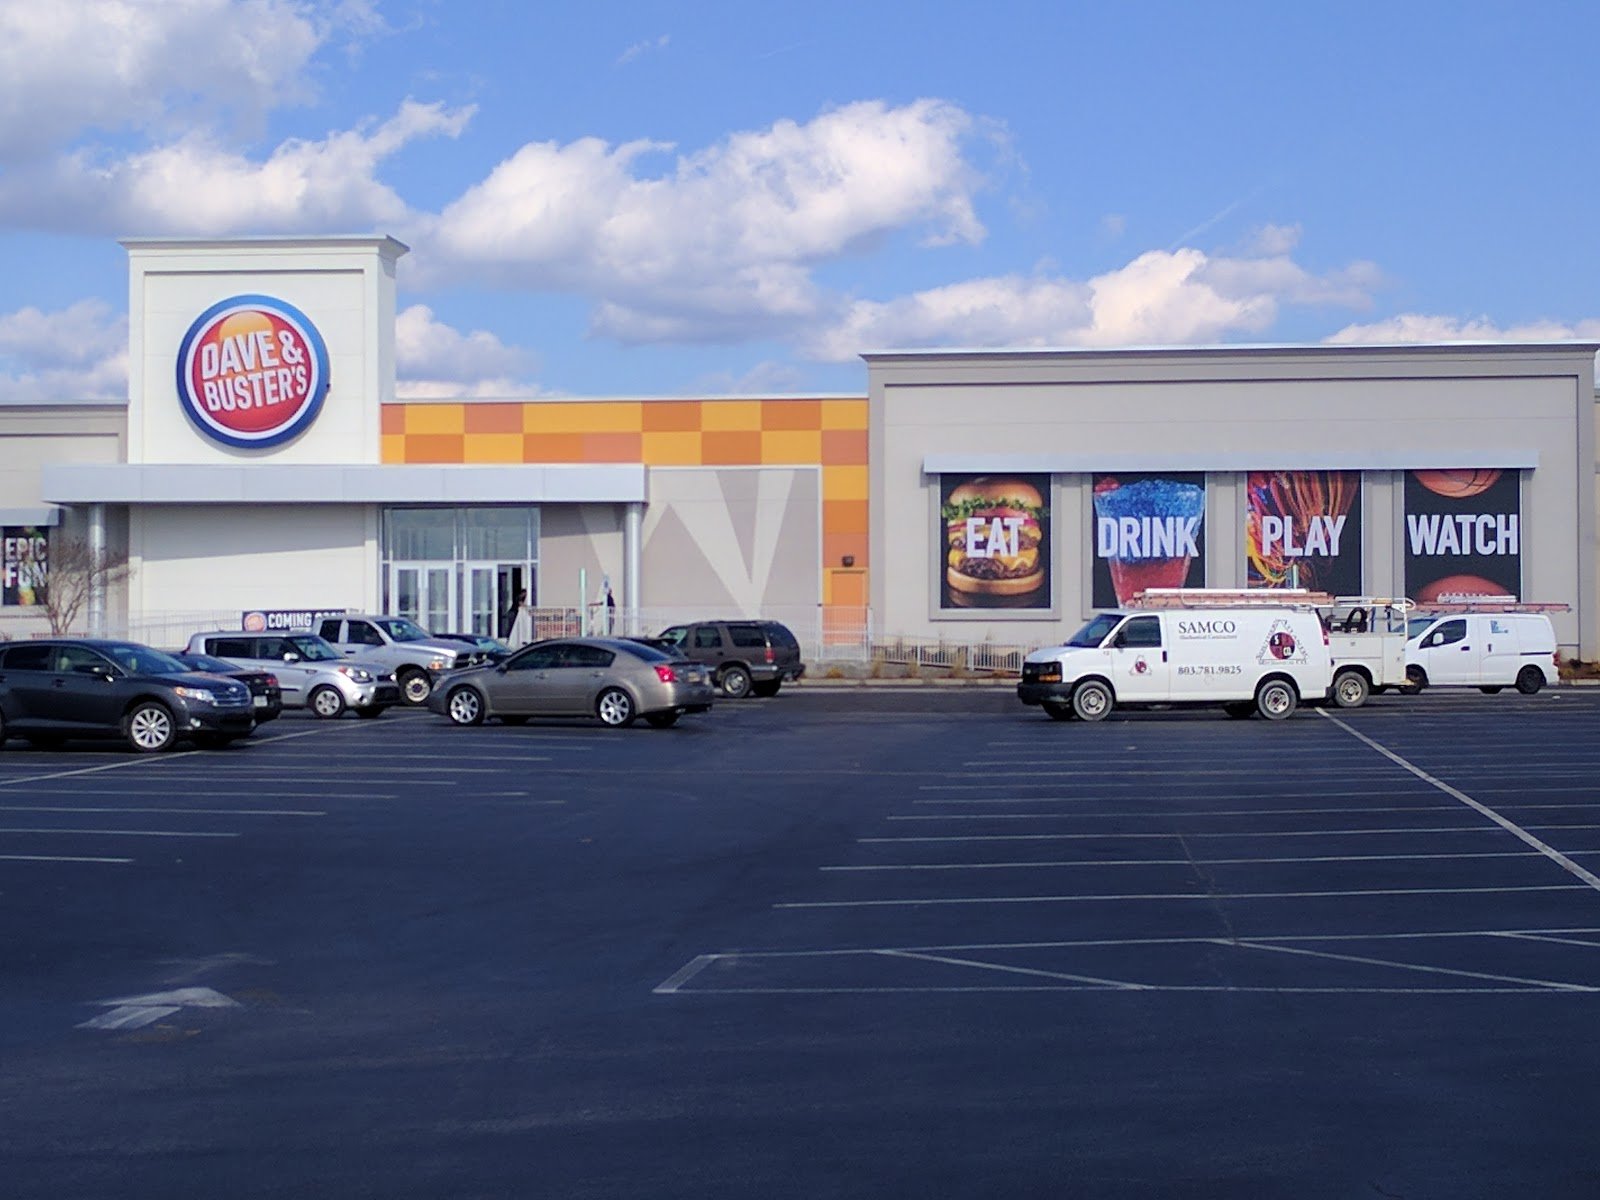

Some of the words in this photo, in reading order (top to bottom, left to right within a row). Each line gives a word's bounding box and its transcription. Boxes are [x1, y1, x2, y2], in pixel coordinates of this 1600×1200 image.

[201, 330, 279, 380] DAVE
[278, 330, 305, 365] &
[203, 365, 307, 412] BUSTER'S
[5, 537, 47, 560] EPIC
[966, 517, 1025, 558] EAT
[1098, 517, 1199, 557] DRINK
[1262, 515, 1347, 556] PLAY
[1407, 514, 1518, 555] WATCH
[5, 562, 47, 587] FUN
[268, 613, 312, 628] COMING
[1178, 621, 1236, 634] SAMCO
[1178, 665, 1242, 675] 803.781.9825
